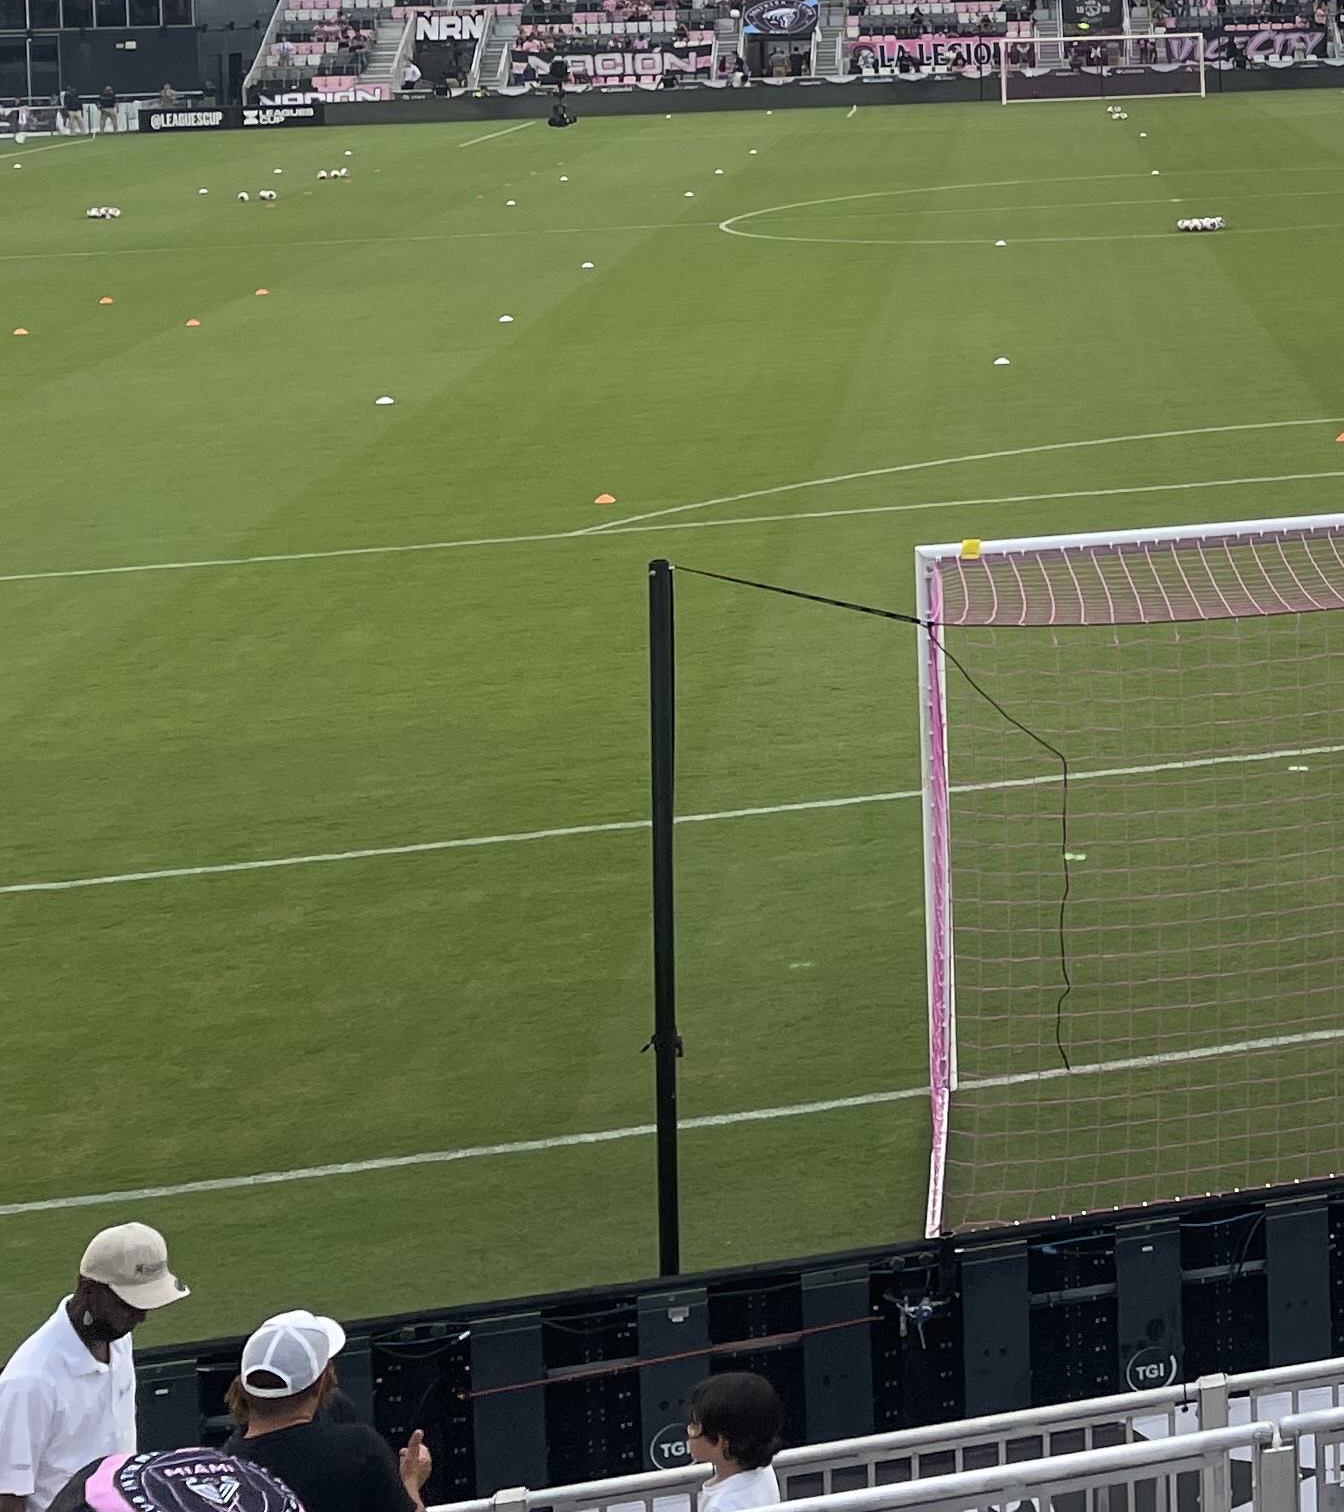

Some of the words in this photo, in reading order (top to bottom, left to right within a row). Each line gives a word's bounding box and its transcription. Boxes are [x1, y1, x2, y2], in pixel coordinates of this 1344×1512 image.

[415, 14, 484, 41] NRN
[1246, 30, 1326, 61] CITY
[150, 110, 223, 130] @LEAGUESCUP
[258, 107, 314, 119] LEAGUES
[258, 114, 286, 125] CUP
[1135, 1362, 1165, 1381] TGI
[659, 1440, 691, 1458] TGI
[163, 1463, 235, 1478] MIAMI
